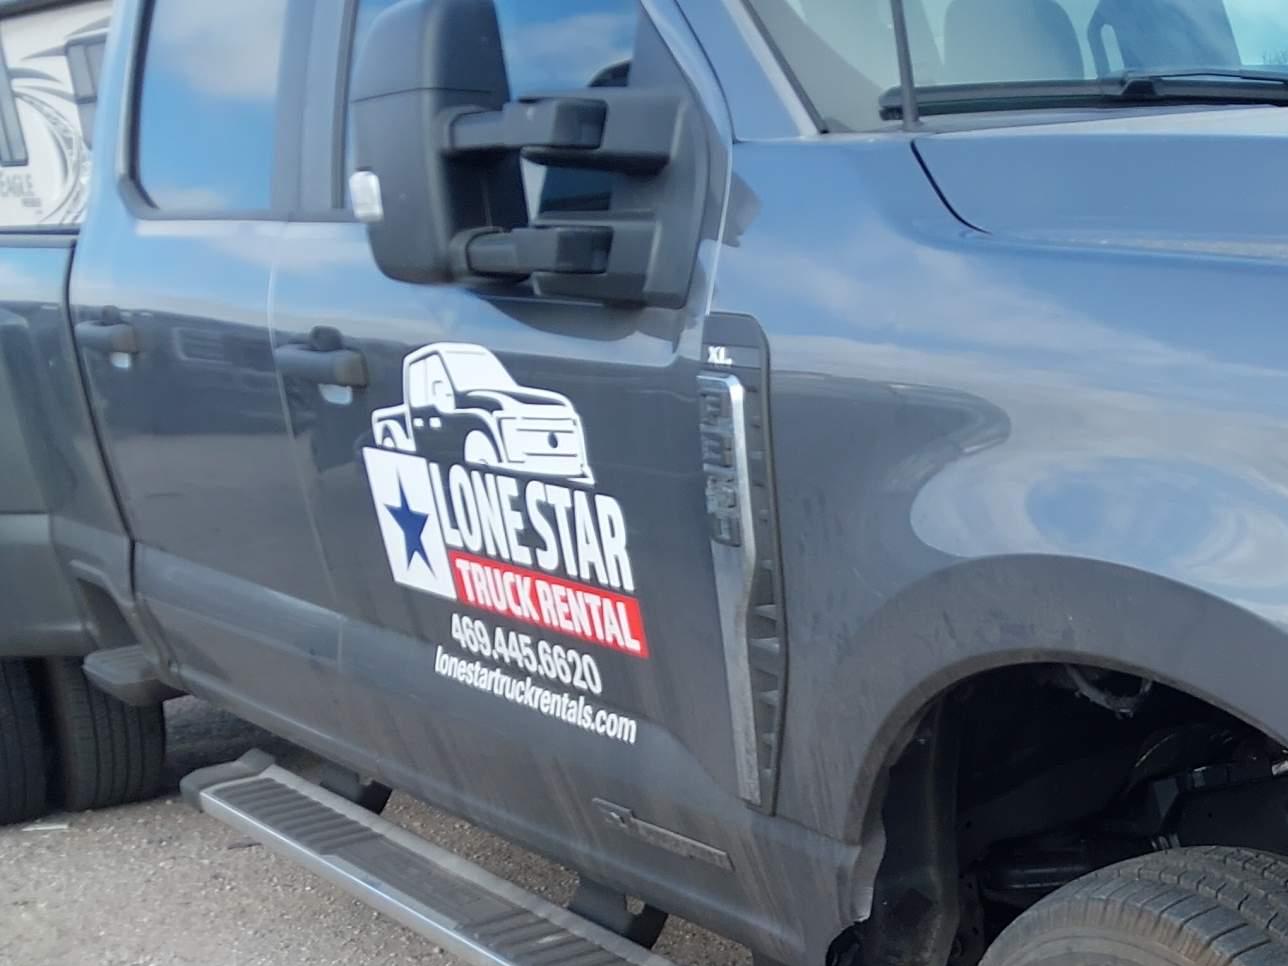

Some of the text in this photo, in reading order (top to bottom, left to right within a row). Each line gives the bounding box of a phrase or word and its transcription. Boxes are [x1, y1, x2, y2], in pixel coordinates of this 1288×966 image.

[707, 345, 733, 365] XL
[428, 461, 635, 592] LONE STAR
[455, 558, 642, 652] TRUCK RENTAL
[434, 644, 638, 745] lonestartruckrentals.com
[450, 612, 603, 695] 469.445.6620
